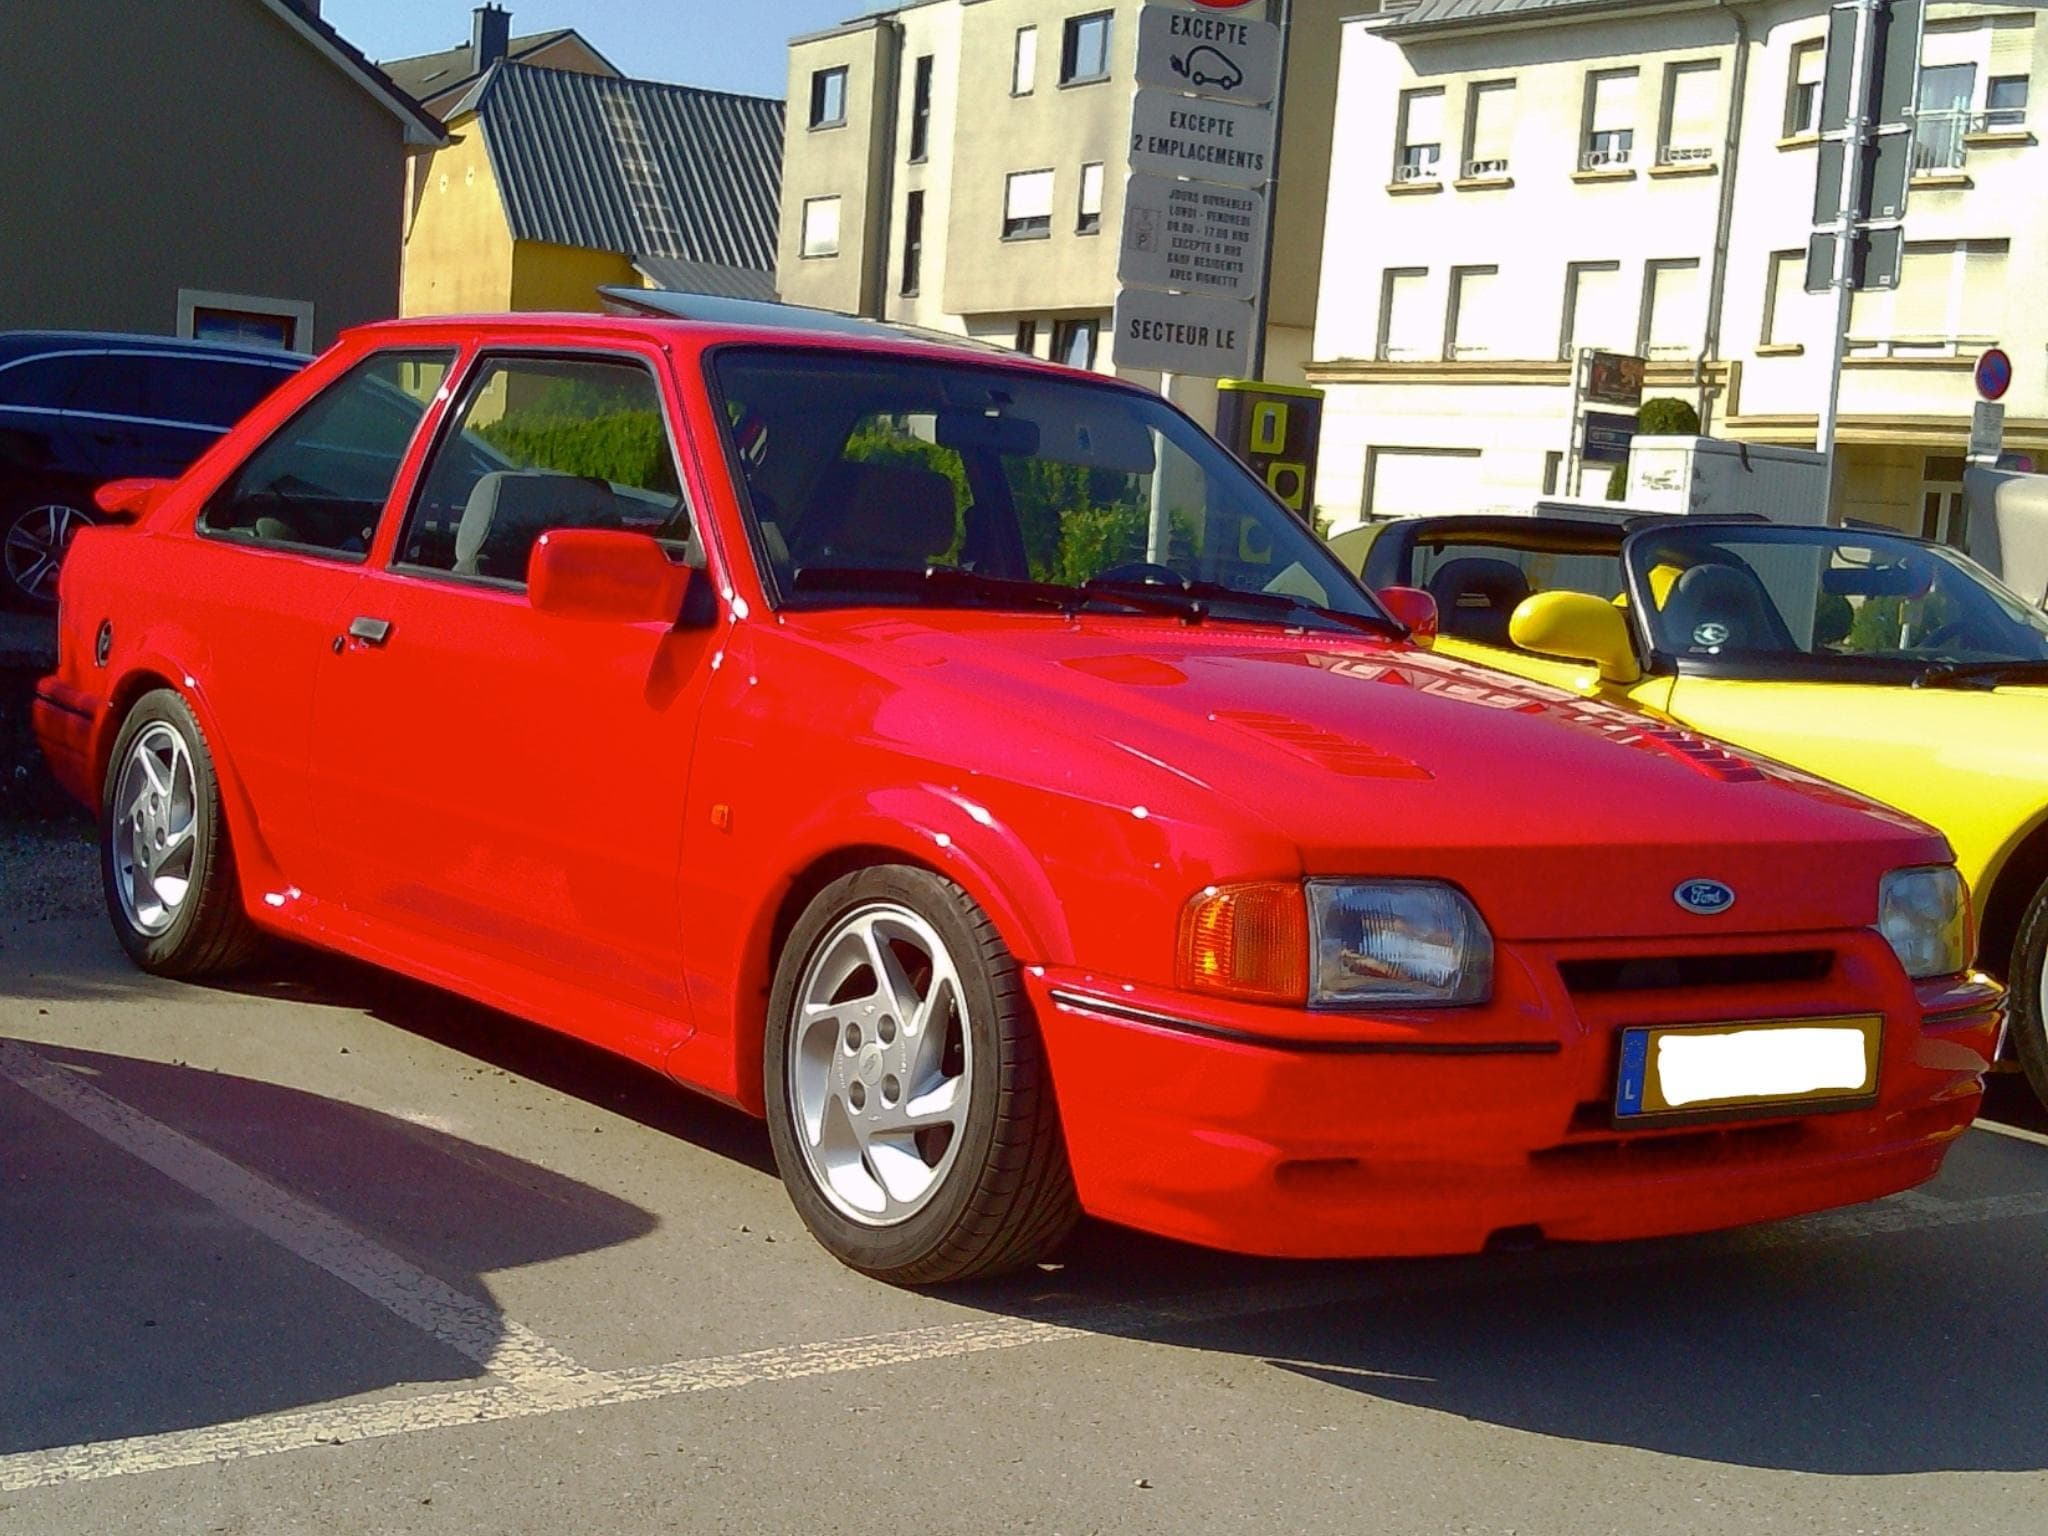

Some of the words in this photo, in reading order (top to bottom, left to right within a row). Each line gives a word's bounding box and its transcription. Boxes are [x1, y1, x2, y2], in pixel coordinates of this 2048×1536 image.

[1171, 15, 1248, 45] EXCEPTE
[1170, 111, 1234, 137] EXCEPTE
[1134, 134, 1143, 150] 2
[1149, 137, 1263, 170] EMPLACEMENTS
[1172, 237, 1211, 253] EXCEPTE
[1169, 269, 1192, 281] AVEC
[1130, 319, 1209, 346] SECTEUR
[1216, 329, 1235, 349] LE
[1691, 885, 1720, 905] Ford
[1625, 1079, 1635, 1100] L
